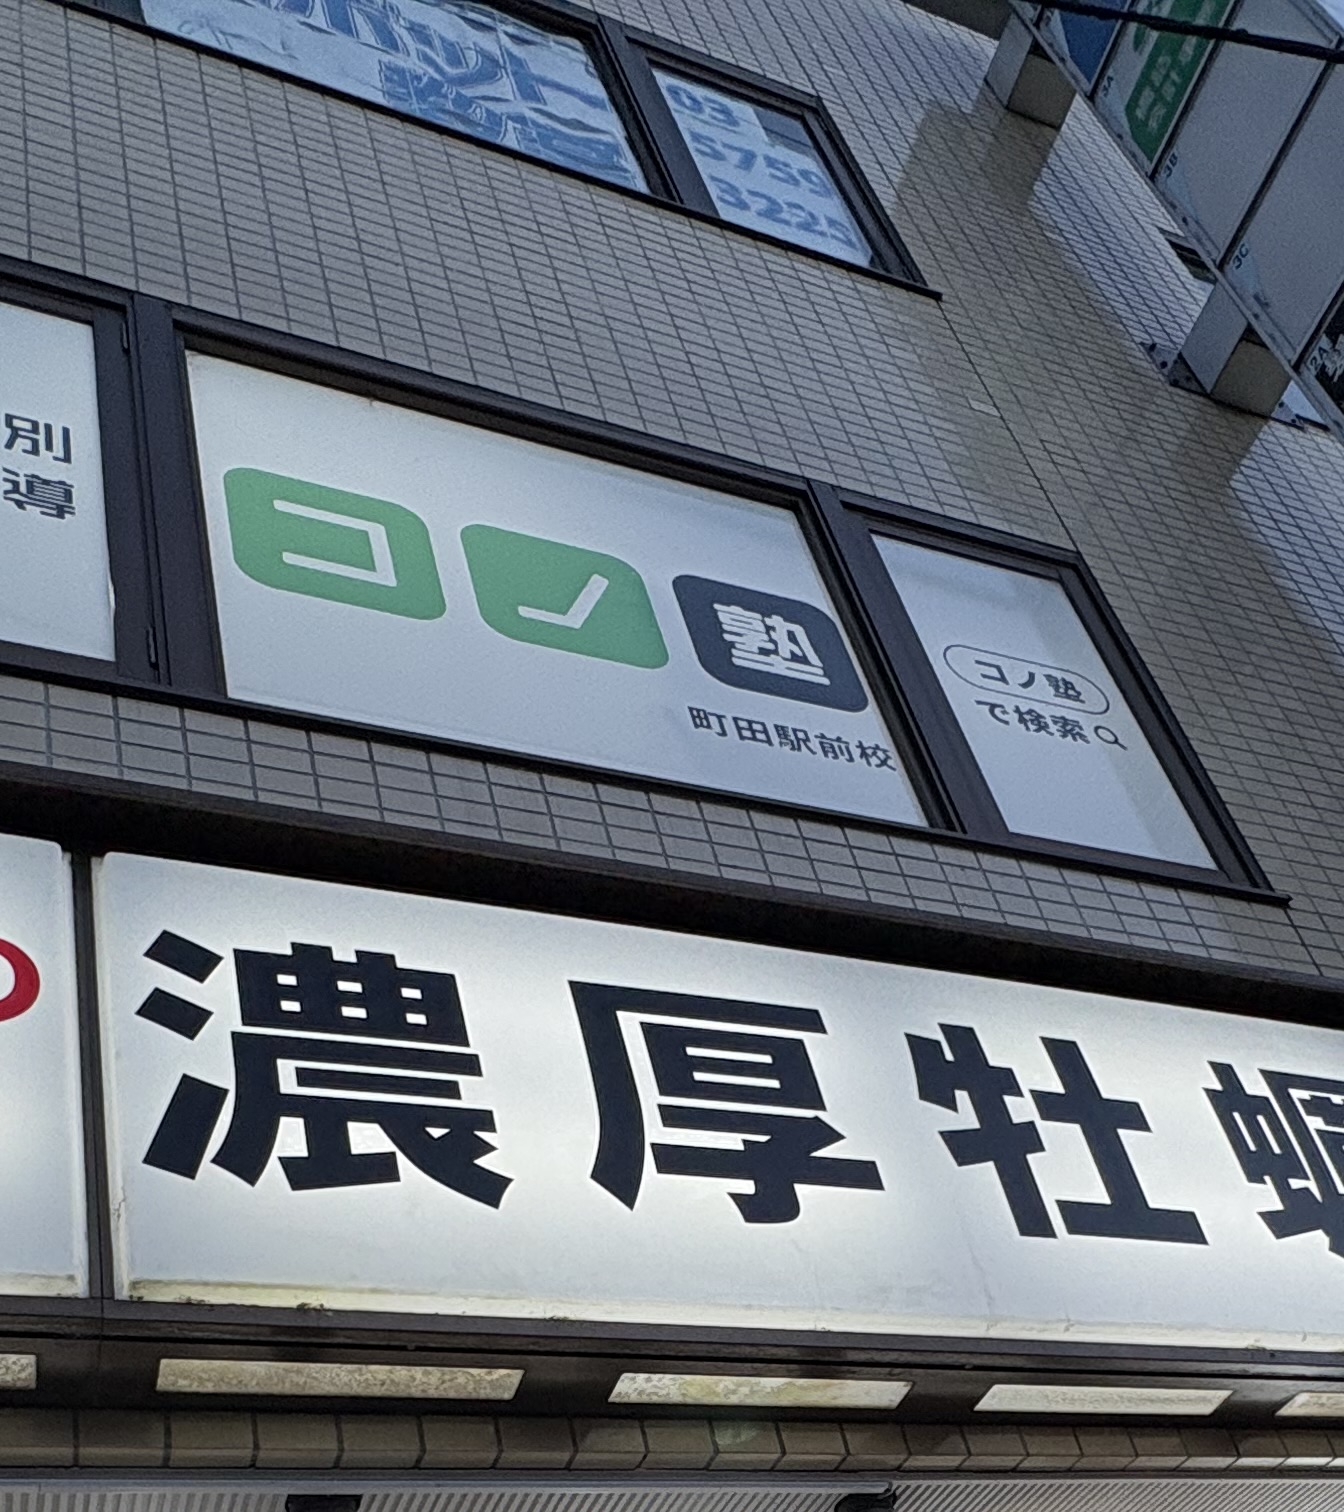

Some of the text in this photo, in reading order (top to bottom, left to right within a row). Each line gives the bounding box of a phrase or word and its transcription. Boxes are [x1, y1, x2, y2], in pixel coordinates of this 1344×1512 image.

[665, 84, 740, 127] 03
[689, 130, 834, 198] 5759
[972, 655, 1086, 706] コノ塾
[688, 705, 898, 772] 町田駅前校
[973, 698, 1090, 747] で検索
